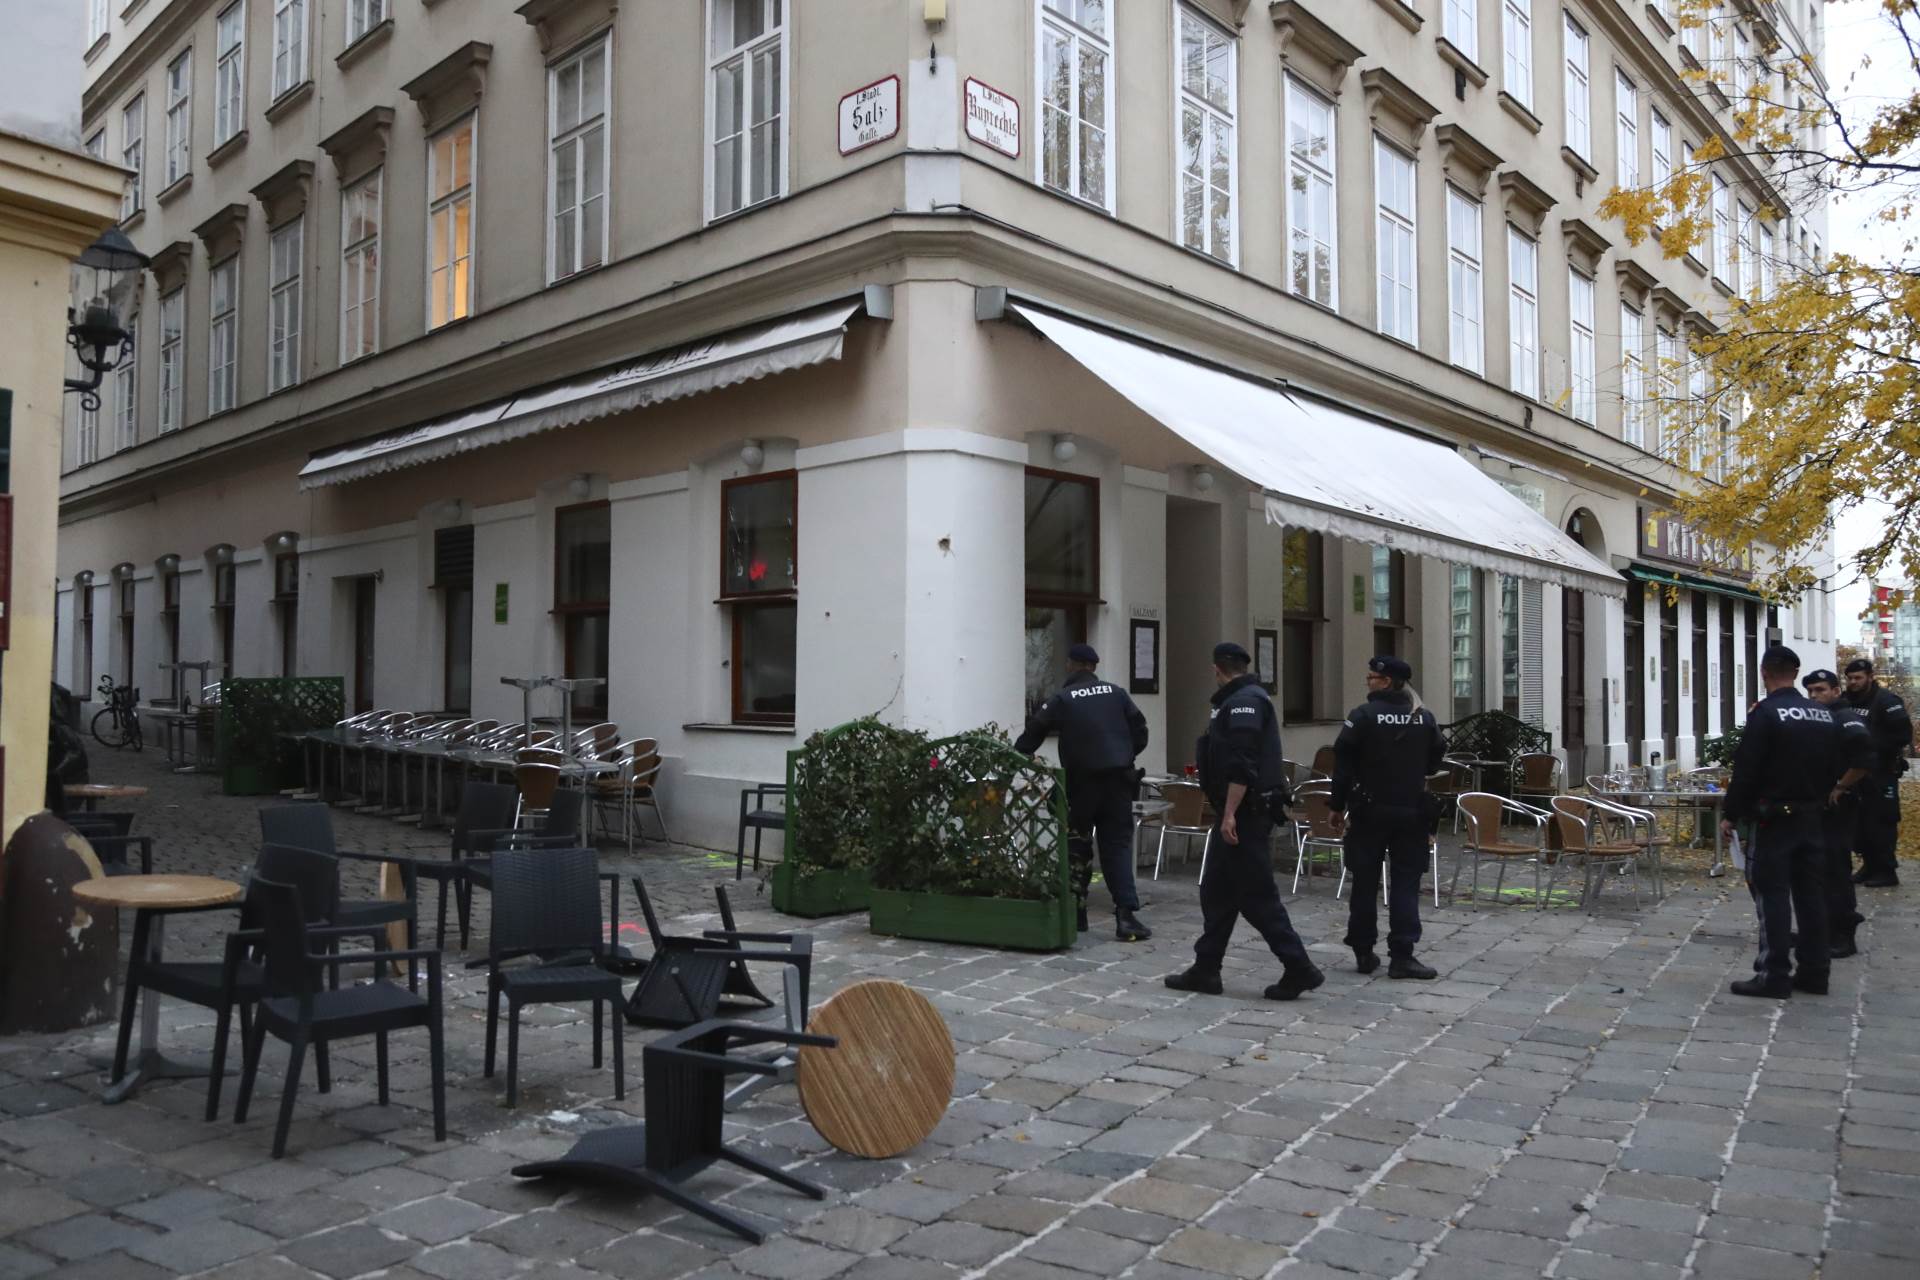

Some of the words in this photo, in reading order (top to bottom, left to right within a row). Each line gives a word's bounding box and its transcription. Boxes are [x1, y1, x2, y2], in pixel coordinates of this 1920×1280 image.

[968, 92, 1017, 136] Ruprechts
[1071, 685, 1112, 698] POLIZEI
[1777, 707, 1833, 723] POLIZEI
